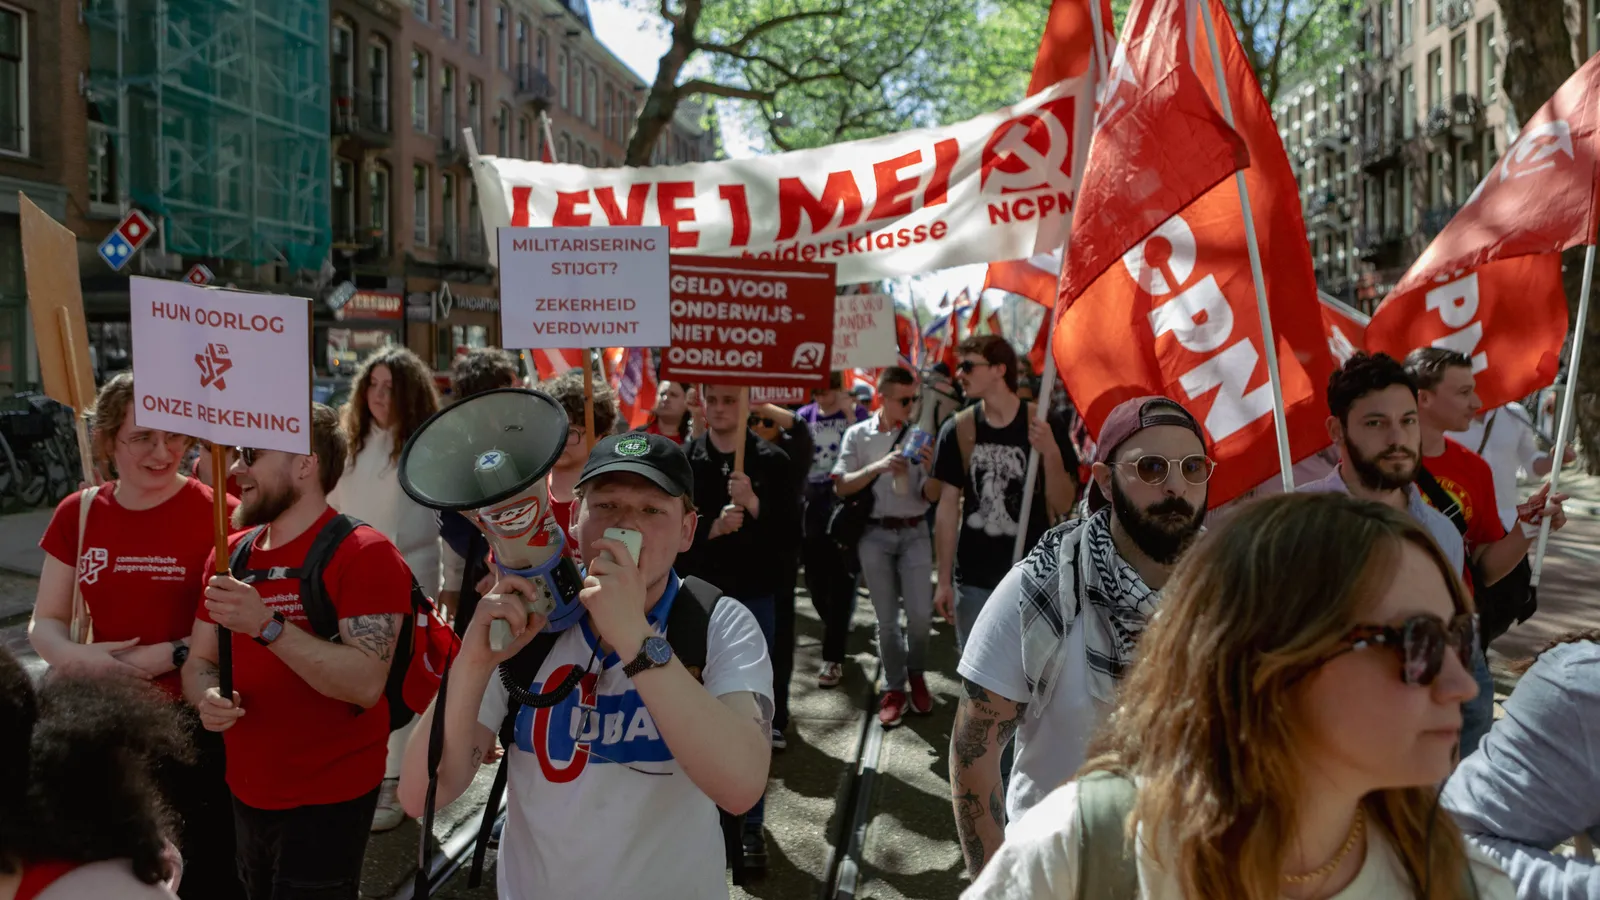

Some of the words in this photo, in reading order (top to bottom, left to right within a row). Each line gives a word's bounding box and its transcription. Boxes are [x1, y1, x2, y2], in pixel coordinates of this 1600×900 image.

[774, 137, 960, 242] MEI
[512, 238, 656, 252] MILITARISERING
[551, 262, 618, 276] STIJGT?
[670, 275, 725, 297] GELD
[727, 279, 788, 299] VOOR
[535, 298, 637, 312] ZEKERHEID
[670, 300, 793, 323] ONDERWIJS
[152, 301, 191, 324] HUN
[195, 308, 285, 334] OORLOG
[533, 321, 640, 335] VERDWIJNT
[671, 322, 717, 342] NIET
[717, 327, 777, 346] VOOR
[668, 349, 763, 368] OORLOG!
[142, 394, 193, 418] ONZE
[197, 403, 301, 434] REKENING
